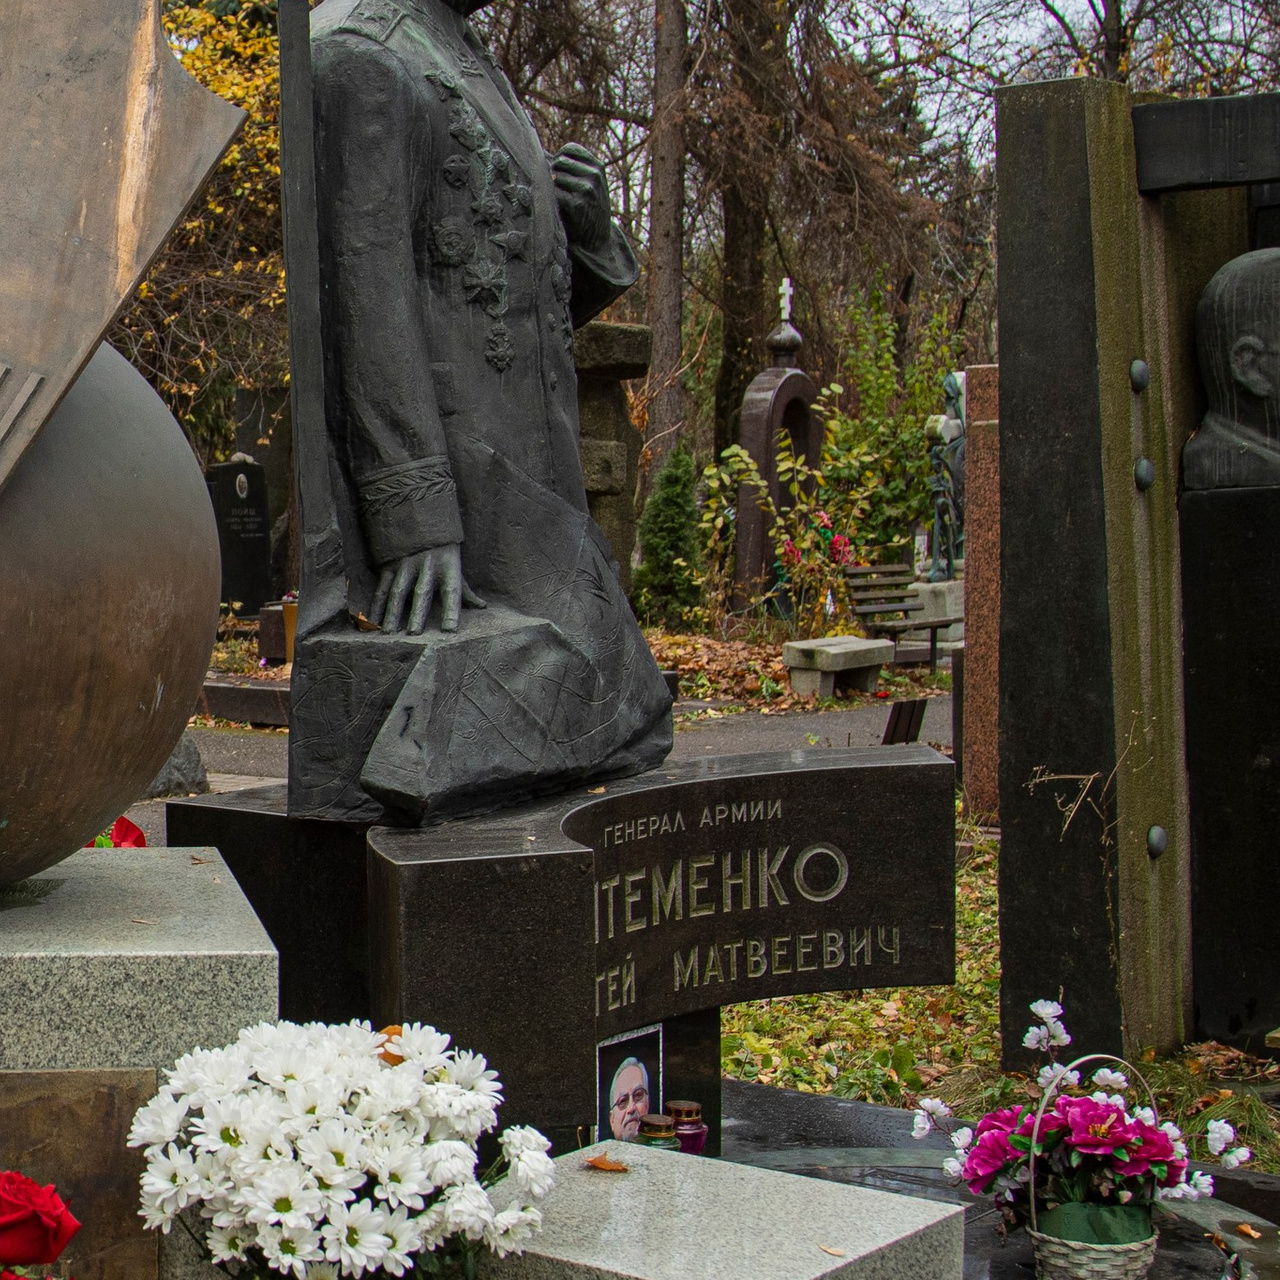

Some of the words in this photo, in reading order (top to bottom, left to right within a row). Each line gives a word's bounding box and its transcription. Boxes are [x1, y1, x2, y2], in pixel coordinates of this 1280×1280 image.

[604, 811, 686, 848] ГЕНЕРАЛ
[699, 799, 783, 827] АРМИИ
[673, 926, 900, 992] МАТВЕЕВИЧ
